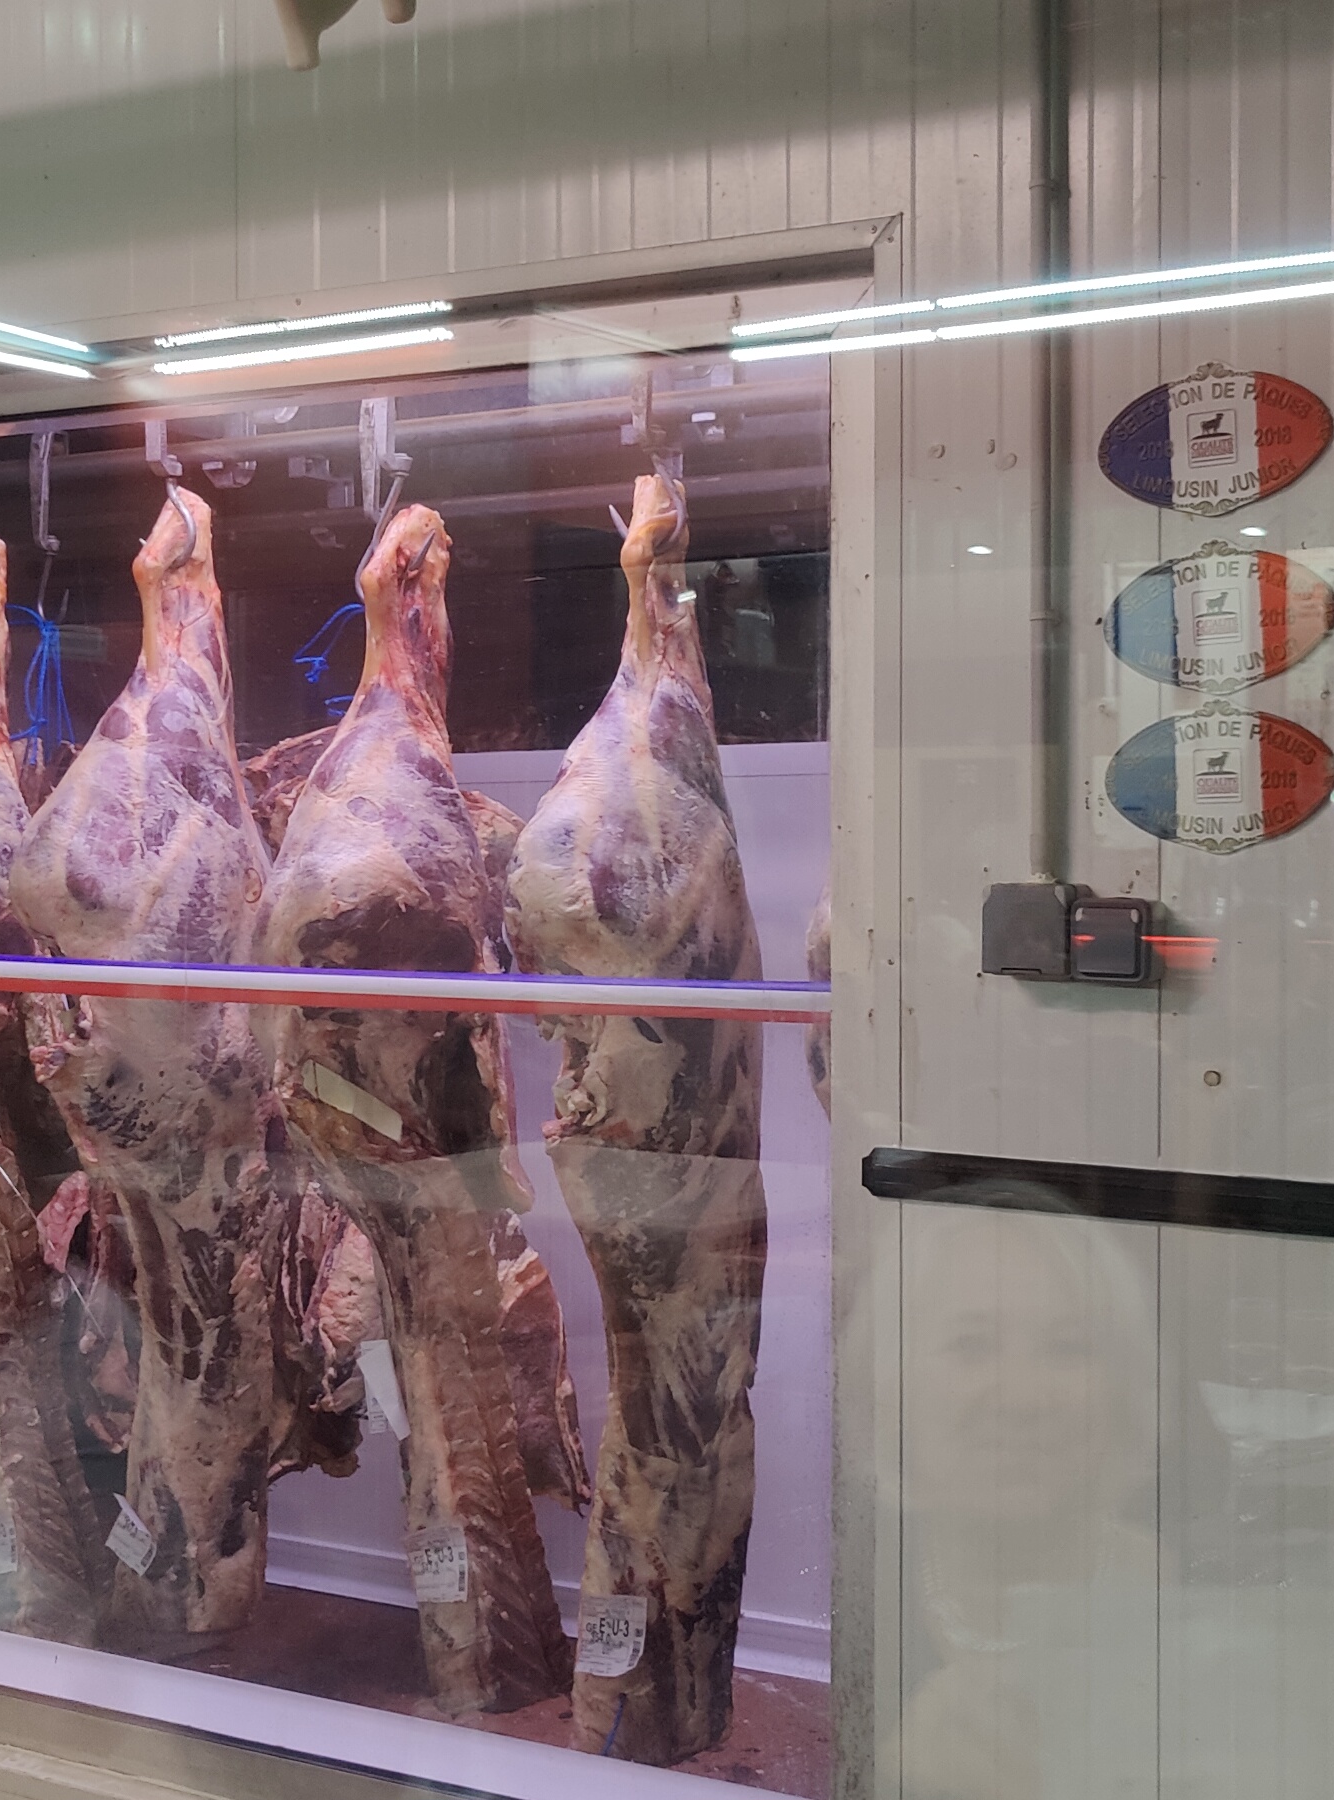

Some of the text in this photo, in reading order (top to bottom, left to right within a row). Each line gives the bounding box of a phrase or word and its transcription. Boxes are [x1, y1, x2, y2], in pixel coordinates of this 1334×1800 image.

[1211, 382, 1235, 399] DE
[1132, 457, 1298, 498] LIMOUSIN JUNIOR
[1216, 561, 1239, 577] DE
[1219, 721, 1242, 737] DE
[1233, 803, 1299, 833] JUNIOR
